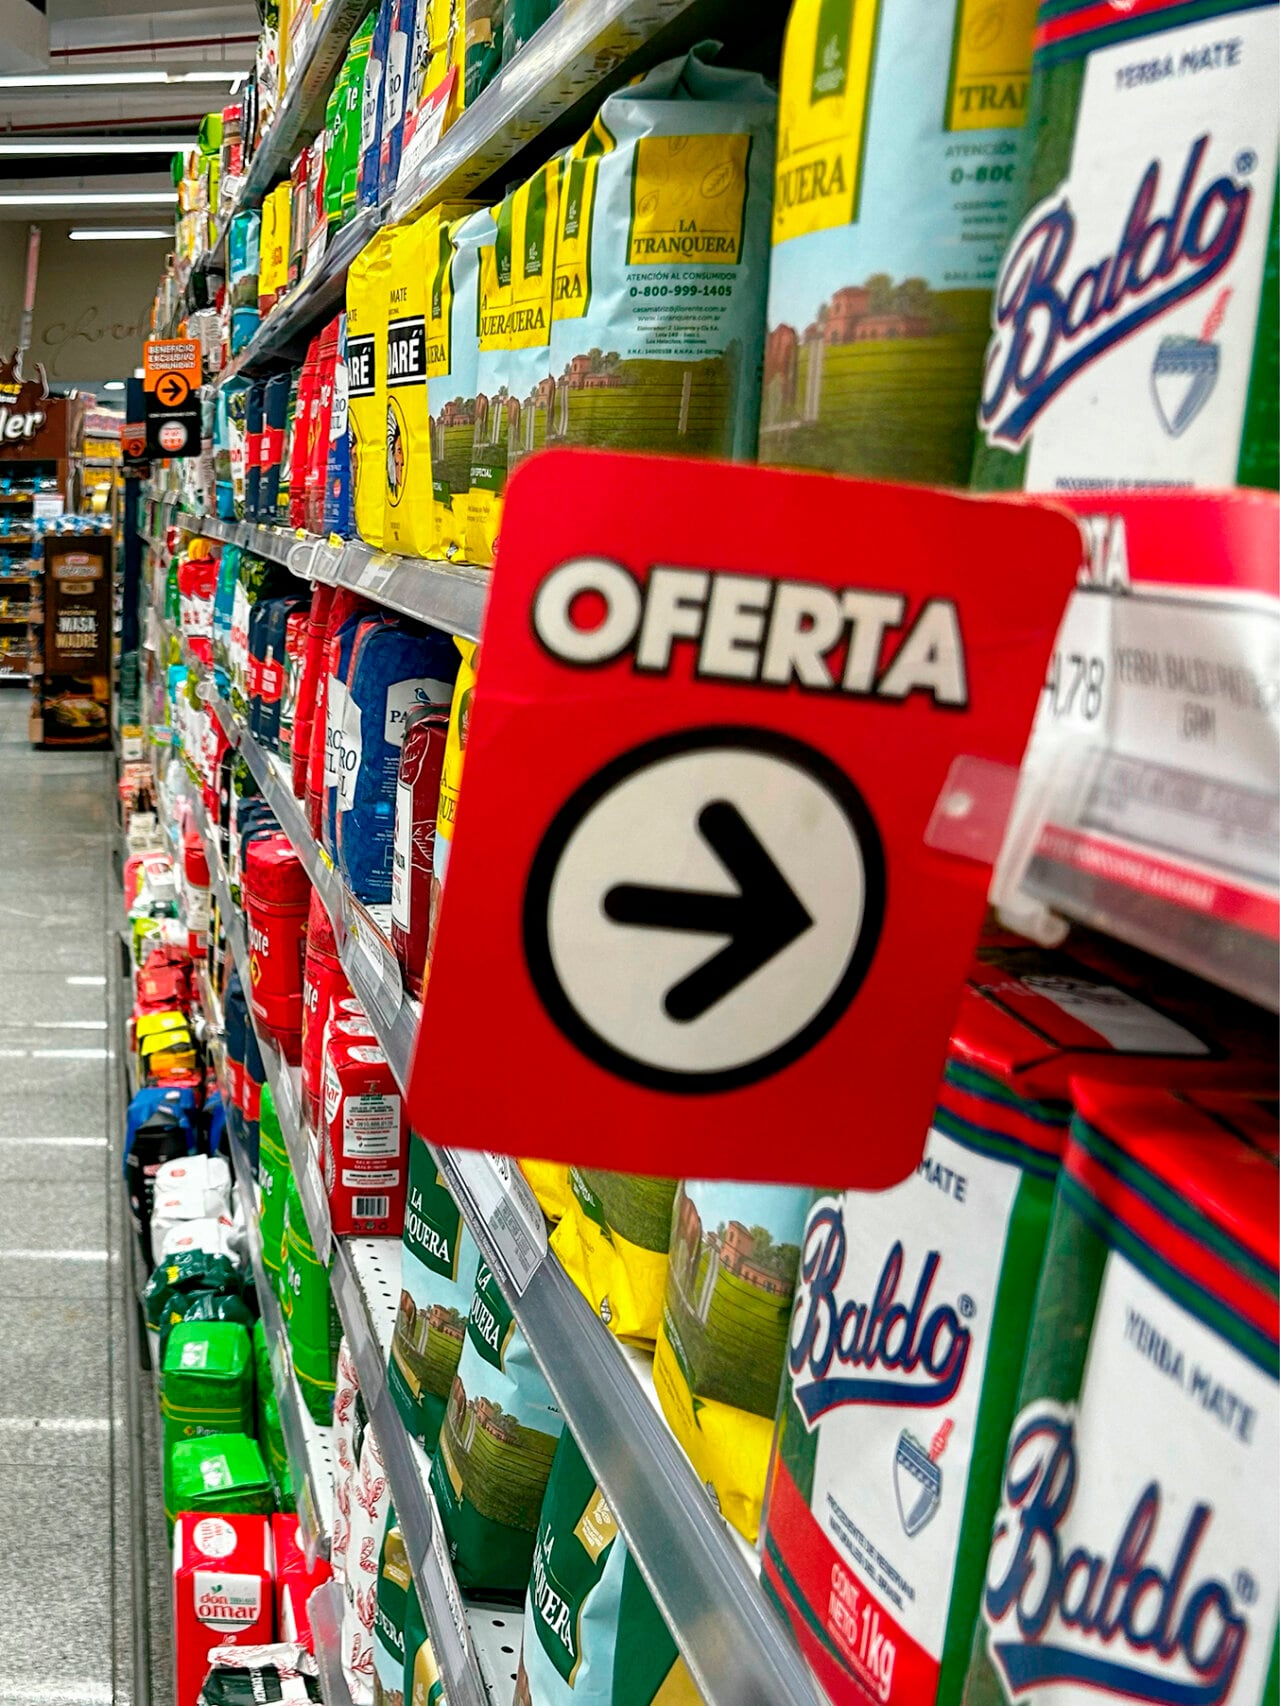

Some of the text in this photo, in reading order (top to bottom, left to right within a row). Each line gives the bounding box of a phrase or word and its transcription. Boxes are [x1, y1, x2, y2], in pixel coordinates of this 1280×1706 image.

[1117, 36, 1244, 89] YERBA MATE
[679, 219, 697, 233] LA
[634, 237, 736, 257] TRANQUERA
[626, 271, 669, 281] ATENCIÓN
[682, 272, 737, 281] CONSUMIDOR
[982, 134, 1255, 440] Baldo
[390, 288, 407, 303] MATE
[630, 285, 732, 297] 0-800-999-1405
[59, 617, 96, 632] MASA
[533, 557, 967, 706] OFERTA
[55, 633, 98, 648] MADRE
[411, 1188, 422, 1212] LA
[477, 1263, 489, 1292] LA
[788, 1203, 971, 1421] Baldo
[1126, 1305, 1255, 1445] YERBA MATE
[985, 1413, 1247, 1695] Baldo
[200, 1593, 228, 1604] don
[199, 1604, 257, 1619] omar
[828, 1590, 858, 1646] NETO
